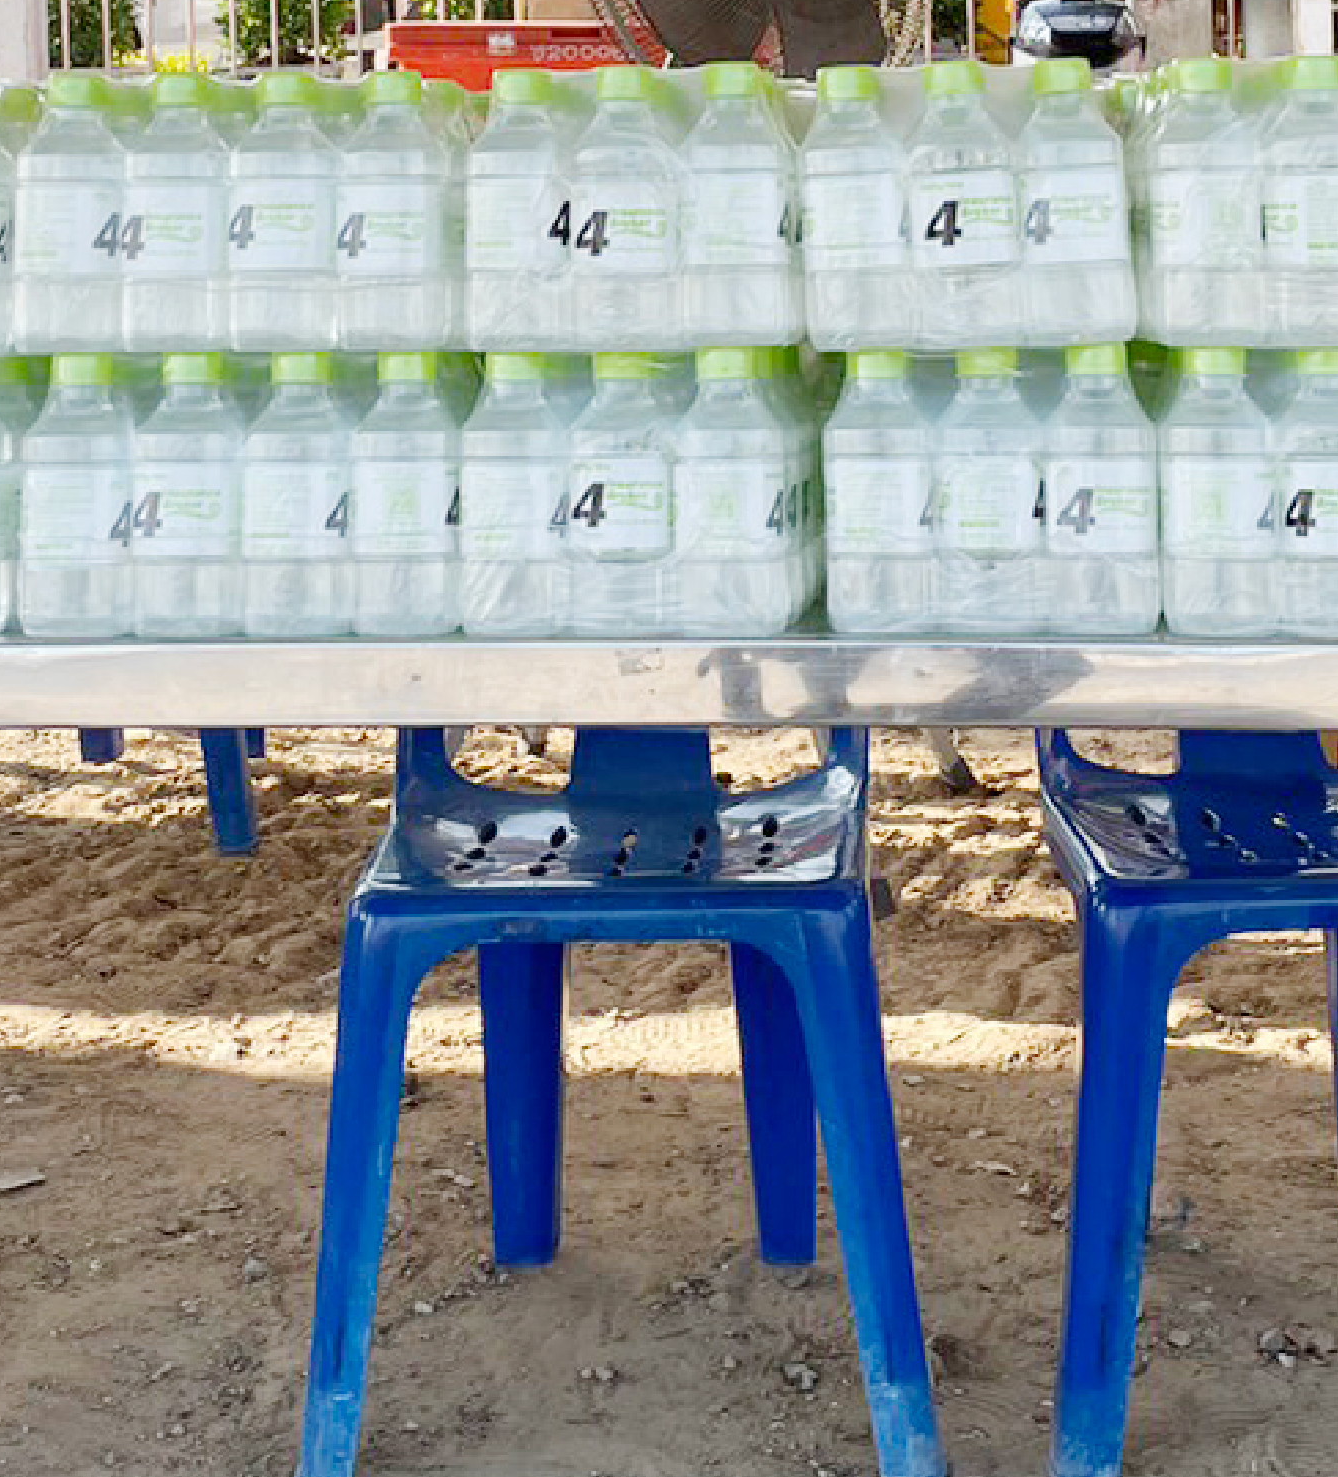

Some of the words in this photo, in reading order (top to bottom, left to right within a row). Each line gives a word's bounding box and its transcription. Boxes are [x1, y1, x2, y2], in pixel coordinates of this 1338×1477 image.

[93, 212, 120, 256] 4
[121, 215, 145, 260] 4
[229, 205, 254, 249] 4
[338, 213, 366, 259] 4
[575, 210, 609, 256] 4
[925, 200, 961, 245] 4
[1026, 199, 1053, 244] 4
[134, 491, 162, 537] 4
[572, 483, 604, 527] 4
[1057, 488, 1095, 534] 4
[1285, 489, 1316, 536] 4
